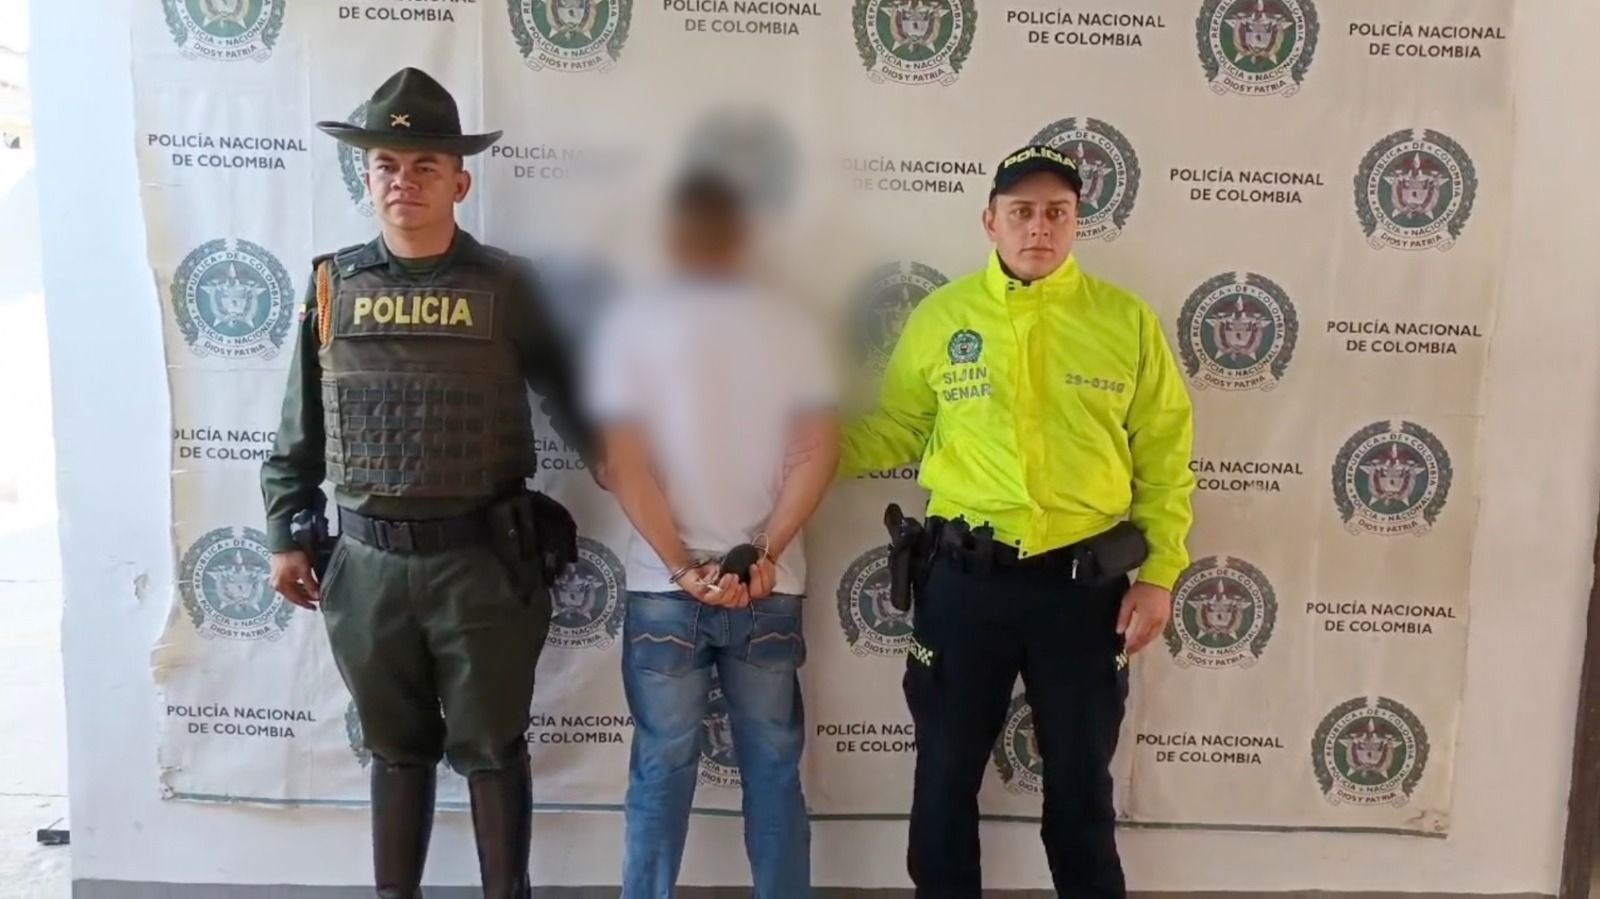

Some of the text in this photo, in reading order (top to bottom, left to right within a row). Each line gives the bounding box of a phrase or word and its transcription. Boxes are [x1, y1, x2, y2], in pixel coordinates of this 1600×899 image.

[339, 7, 455, 22] DE COLOMBIA
[734, 1, 821, 16] NACIONAL
[1007, 9, 1165, 28] POLICÍA NACIONAL
[685, 19, 799, 35] DE COLOMBIA
[1349, 22, 1505, 39] POLICÍA NACIONAL
[1029, 31, 1142, 46] DE COLOMBIA
[1369, 43, 1481, 58] DE COLOMBIA
[148, 133, 307, 151] POLICÍA NACIONAL
[172, 154, 286, 169] DE COLOMBIA
[901, 160, 987, 175] NACIONAL
[514, 165, 535, 178] DE
[1170, 167, 1324, 186] POLICÍA NACIONAL
[878, 179, 964, 193] COLOMBIA
[1190, 189, 1302, 203] DE COLOMBIA
[354, 296, 473, 326] POLICIA
[1327, 319, 1482, 337] POLICÍA NACIONAL
[1346, 340, 1457, 354] DE COLOMBIA
[943, 367, 987, 384] SIJIN
[228, 430, 278, 442] NACIO
[180, 446, 270, 460] DE COLOM
[1220, 461, 1303, 474] NACIONAL
[1197, 478, 1280, 491] COLOMBIA
[1306, 600, 1456, 618] POLICÍA NACIONAL
[1325, 620, 1433, 634] DE COLOMBIA
[167, 703, 316, 722] POLICÍA NACIONAL
[561, 716, 634, 727] NACIONA
[817, 721, 877, 735] POLICÍA
[188, 722, 295, 738] DE COLOMBIA
[540, 732, 624, 743] COLOMBIA
[837, 741, 917, 752] DE COLOM
[1136, 732, 1283, 748] POLICÍA NACIONAL
[1156, 751, 1261, 765] DE COLOMBIA
